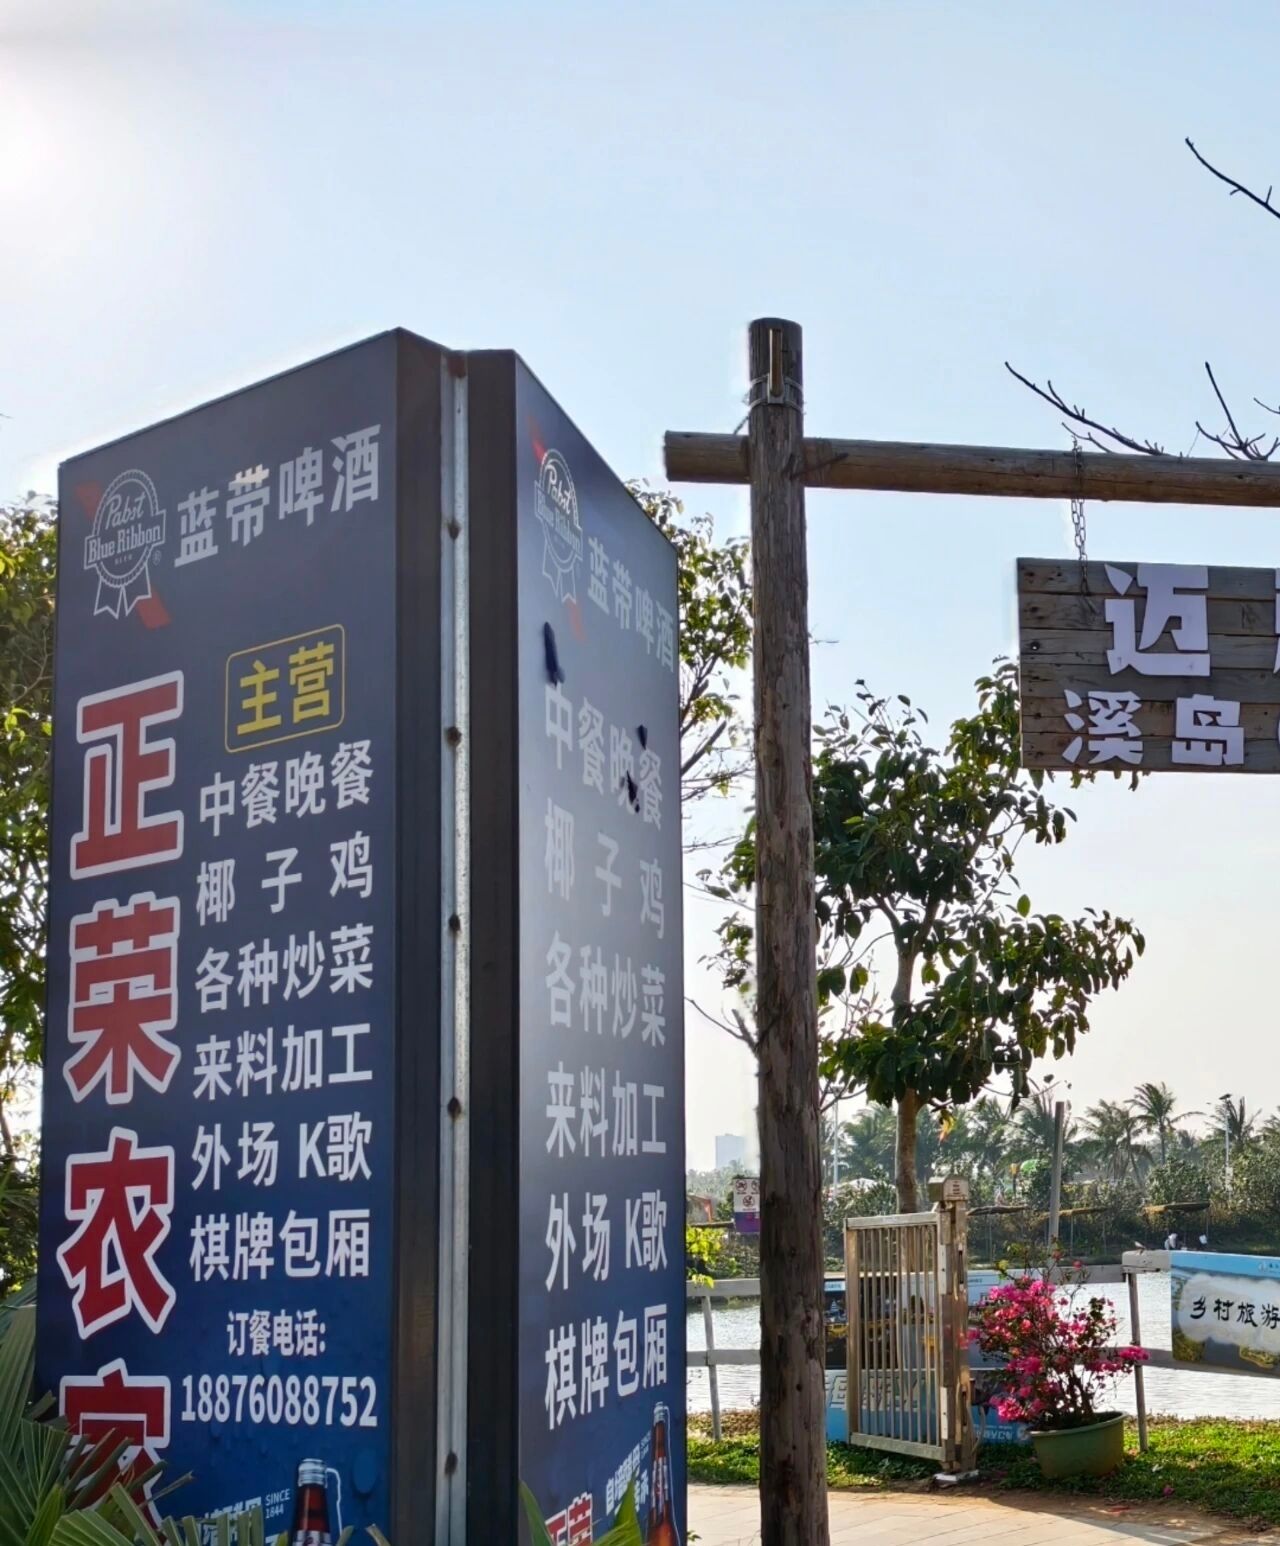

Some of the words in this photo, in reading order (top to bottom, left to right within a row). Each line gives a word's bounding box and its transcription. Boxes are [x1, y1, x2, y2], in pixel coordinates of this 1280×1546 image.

[104, 491, 147, 530] Pabst
[174, 423, 382, 567] 蓝带啤酒
[87, 537, 115, 563] Blue
[117, 523, 161, 554] Ribbon
[587, 536, 674, 673] 蓝带啤酒
[237, 640, 335, 735] 主营
[199, 739, 374, 837] 中餐晚餐
[544, 684, 663, 830] 中餐晚餐
[195, 923, 374, 1014] 各种炒菜
[545, 930, 666, 1047] 各种炒菜
[193, 1022, 374, 1101] 来料加工
[546, 1060, 667, 1158] 来料加工
[189, 1208, 371, 1283] 棋牌包厢
[181, 1374, 379, 1428] 18876088752
[544, 1303, 668, 1430] 棋牌包厢
[264, 1488, 291, 1507] SINCE
[265, 1505, 284, 1520] 1844
